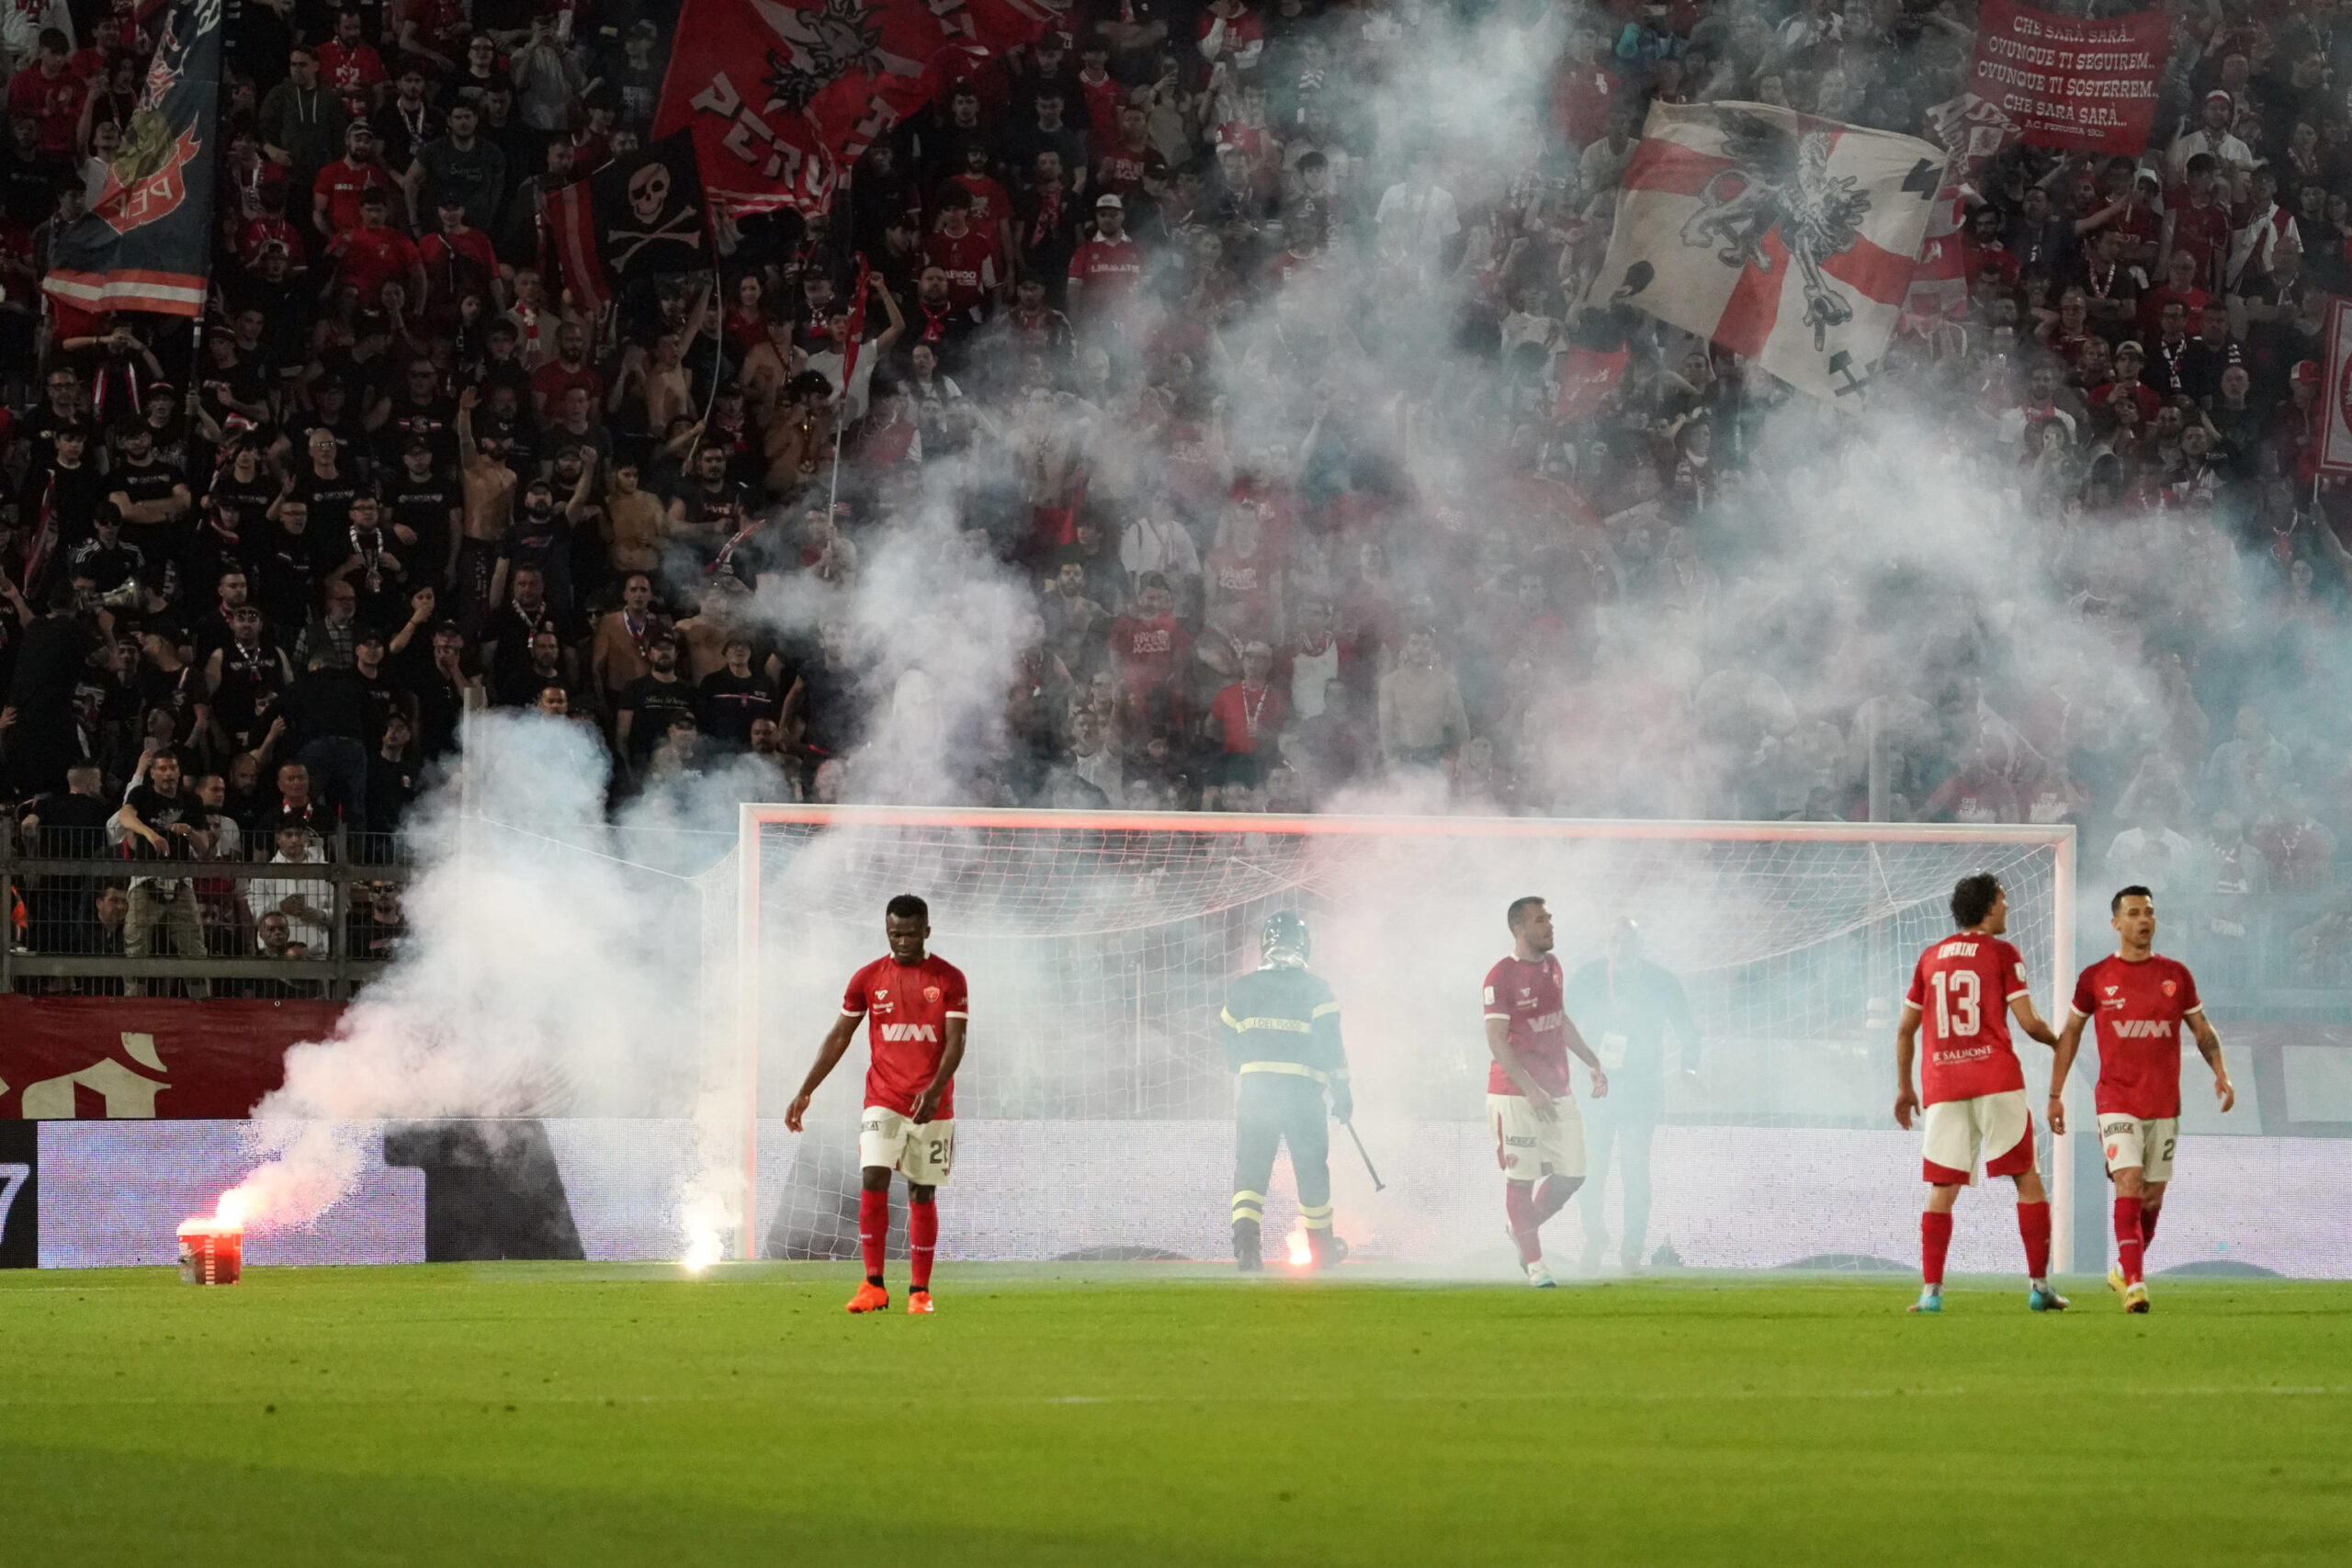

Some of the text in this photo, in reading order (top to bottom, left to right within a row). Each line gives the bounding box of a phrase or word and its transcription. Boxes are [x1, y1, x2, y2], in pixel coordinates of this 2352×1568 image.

[2013, 16, 2041, 36] CHE
[2045, 24, 2086, 43] SARÀ
[1988, 36, 2056, 67] OVUNQUE
[2059, 52, 2073, 69] TI
[1977, 60, 2045, 92] OVUNQUE
[2049, 75, 2064, 95] TI
[2003, 94, 2033, 114] CHE
[2035, 100, 2076, 121] SARÀ
[1930, 969, 1981, 1039] 13
[881, 1023, 938, 1043] VIM
[2111, 1020, 2173, 1039] VIM
